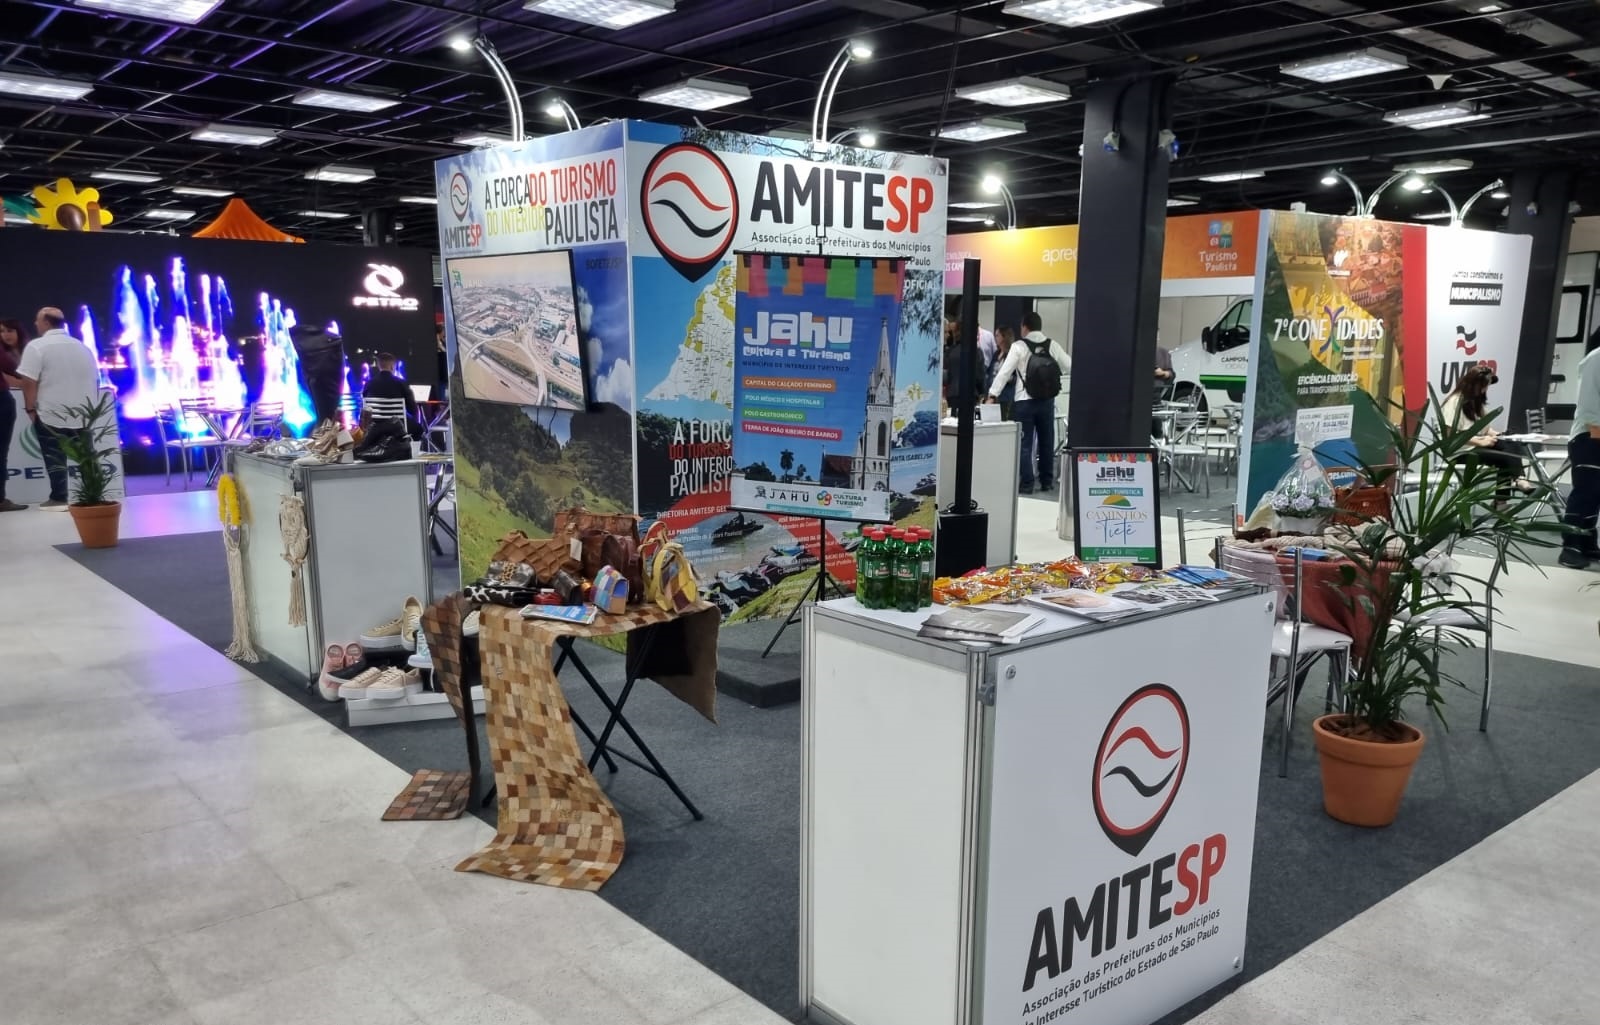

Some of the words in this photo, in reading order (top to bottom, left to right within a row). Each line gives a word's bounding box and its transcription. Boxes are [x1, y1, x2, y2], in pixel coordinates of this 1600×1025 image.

[485, 181, 492, 210] A
[494, 174, 530, 214] FORÇA
[530, 171, 547, 207] DO
[551, 158, 616, 204] TURISMO
[750, 160, 934, 234] AMITESP
[486, 210, 498, 236] DO
[502, 205, 546, 234] INTERIOR
[544, 198, 620, 246] PAULISTA
[444, 222, 482, 250] AMITESP
[752, 231, 803, 247] Associação
[822, 236, 871, 249] Prefeituras
[872, 240, 887, 250] dos
[888, 241, 932, 254] Municípios
[1199, 250, 1238, 262] Turismo
[1206, 262, 1238, 272] Paulista
[1451, 286, 1501, 300] MUNICIPALISMO
[743, 311, 853, 350] Jahu
[800, 349, 851, 362] Turismo
[674, 420, 684, 446] A
[690, 418, 732, 450] FORÇ
[674, 458, 688, 476] DO
[692, 456, 733, 474] INTERIO
[1096, 466, 1135, 478] Jahu
[670, 472, 732, 496] PAULIST
[770, 492, 810, 502] JAHU
[1022, 833, 1226, 992] AMITESP
[1022, 978, 1081, 1016] Associação
[1083, 970, 1100, 984] das
[1103, 940, 1155, 974] Prefeituras
[1157, 932, 1173, 947] dos
[1175, 908, 1220, 938] Municípios
[1036, 997, 1081, 1025] Interesse
[1083, 976, 1123, 1002] Turístico
[1125, 967, 1136, 980] do
[1138, 949, 1167, 974] Estado
[1168, 944, 1179, 958] de
[1180, 935, 1196, 952] São
[1197, 924, 1219, 946] Paulo
